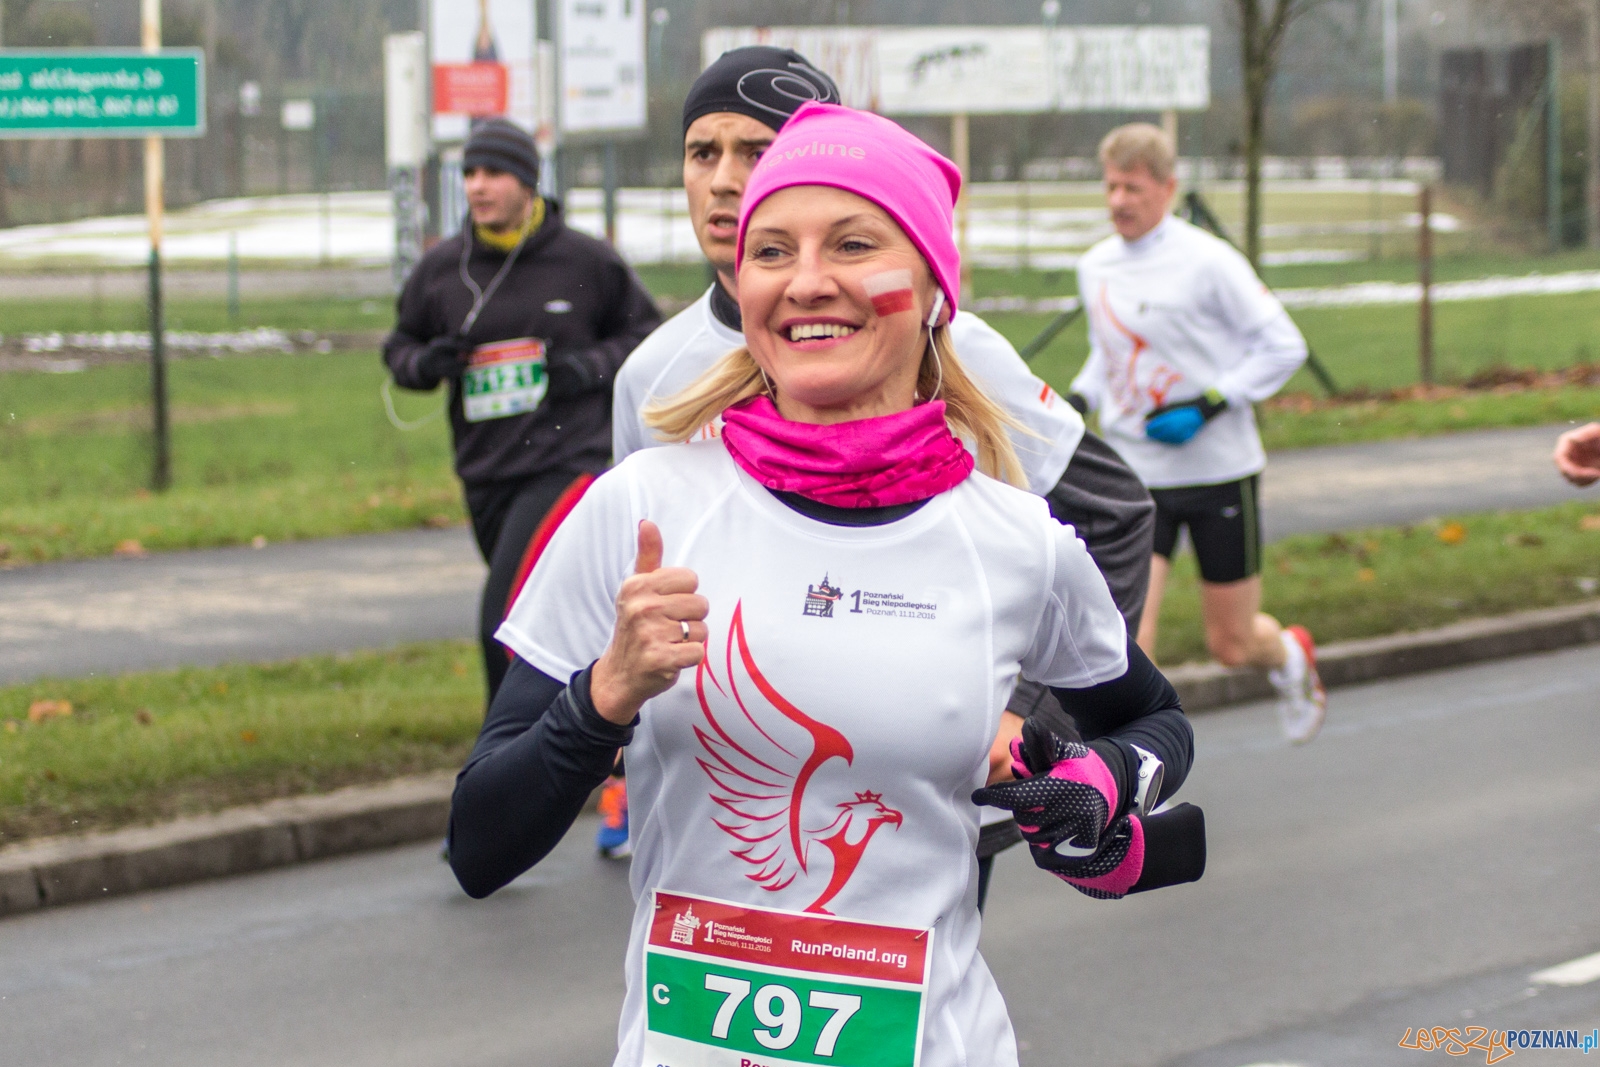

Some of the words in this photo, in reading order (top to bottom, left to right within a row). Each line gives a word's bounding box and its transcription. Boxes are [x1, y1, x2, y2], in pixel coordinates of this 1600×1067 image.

[850, 589, 863, 614] 1
[863, 591, 905, 601] Poznański
[862, 598, 880, 607] Bieg
[881, 600, 937, 611] Niepodległości
[866, 608, 898, 617] Poznań,
[899, 610, 936, 620] 11.11.2016
[703, 920, 715, 943] 1
[714, 922, 746, 934] Poznański
[713, 929, 727, 938] Bieg
[727, 931, 773, 945] Niepodległości
[740, 941, 772, 954] 11.11.2016
[791, 939, 907, 968] RunPoland.org
[704, 973, 863, 1057] 797
